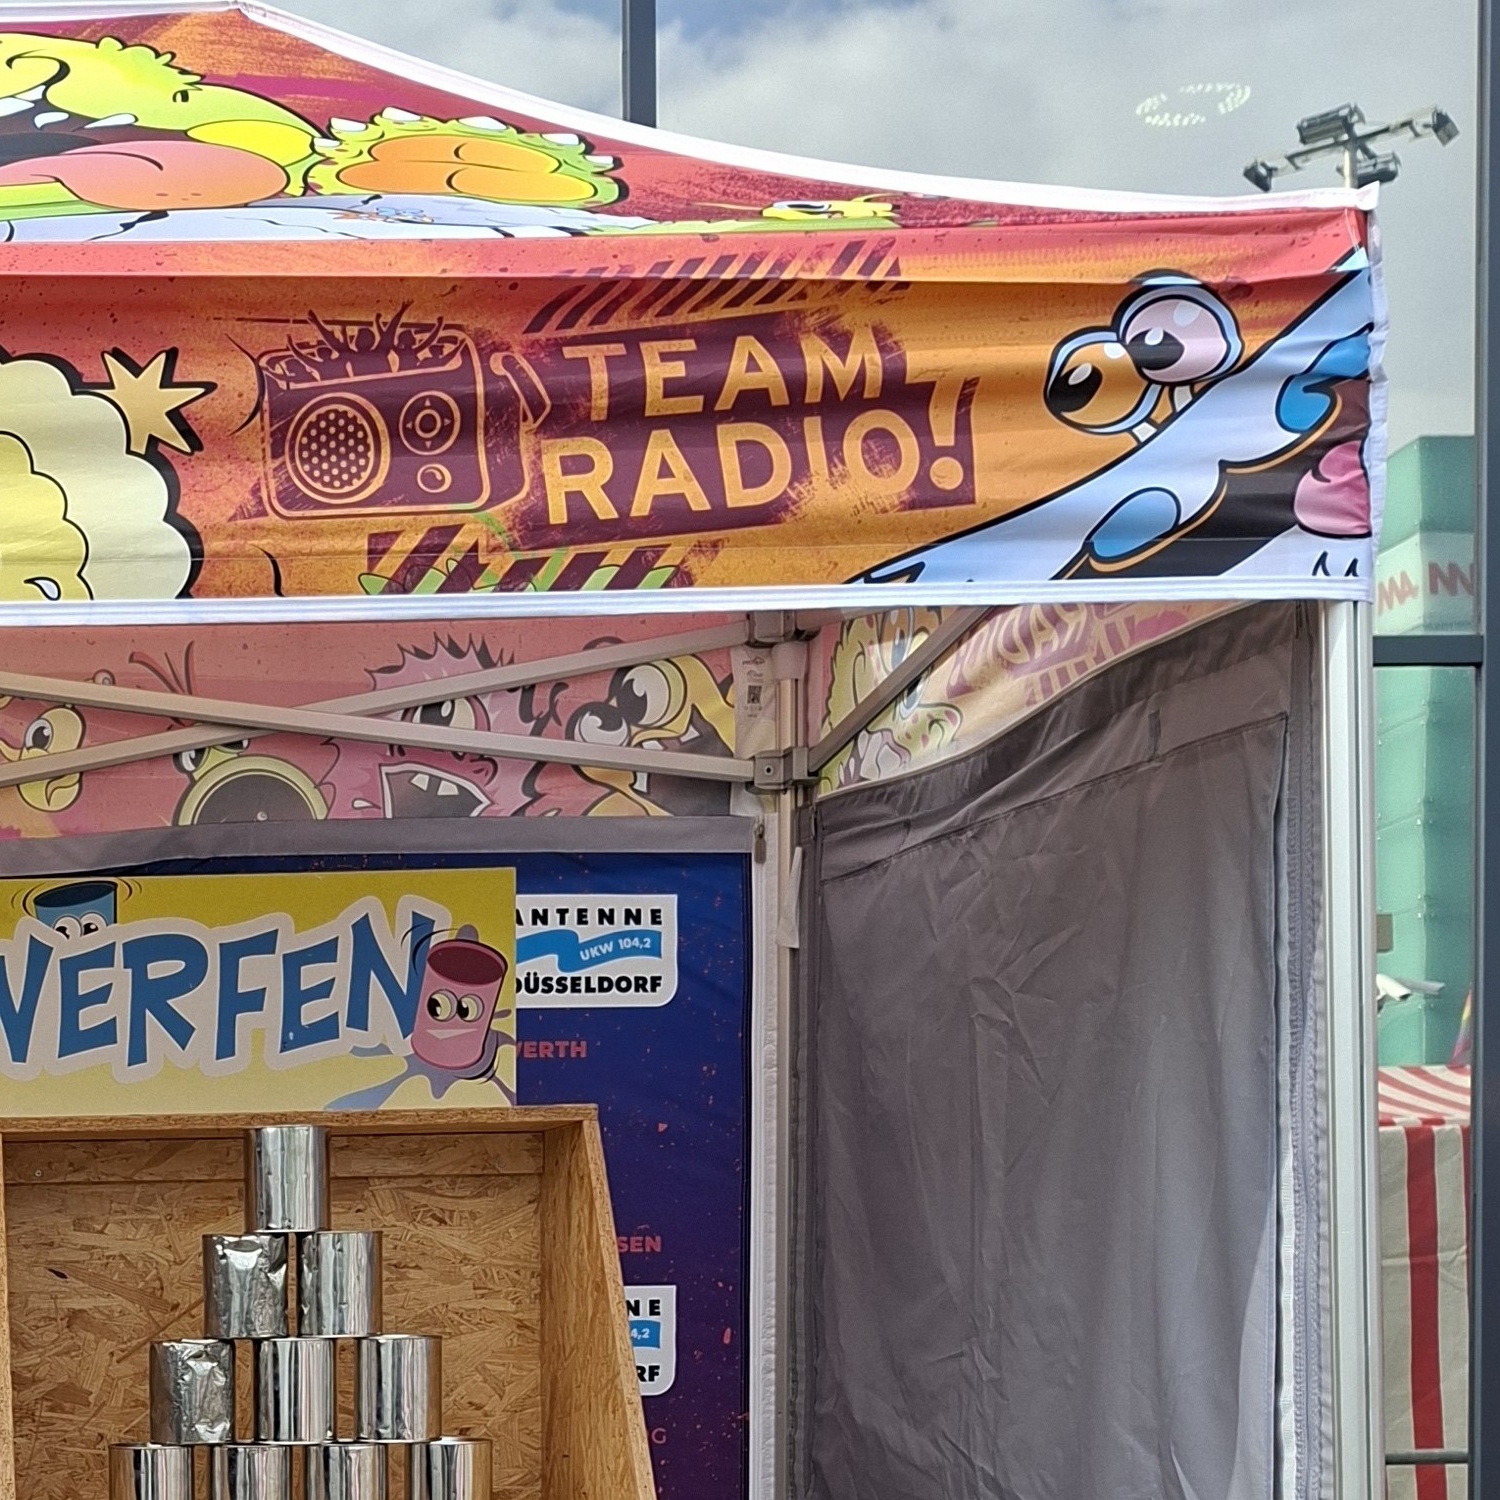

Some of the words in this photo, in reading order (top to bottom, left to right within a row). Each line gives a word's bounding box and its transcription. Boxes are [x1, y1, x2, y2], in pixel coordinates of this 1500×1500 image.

[562, 320, 890, 424] TEAM
[541, 372, 968, 525] RADIO!
[579, 940, 614, 962] UKW
[617, 936, 652, 950] 104,2
